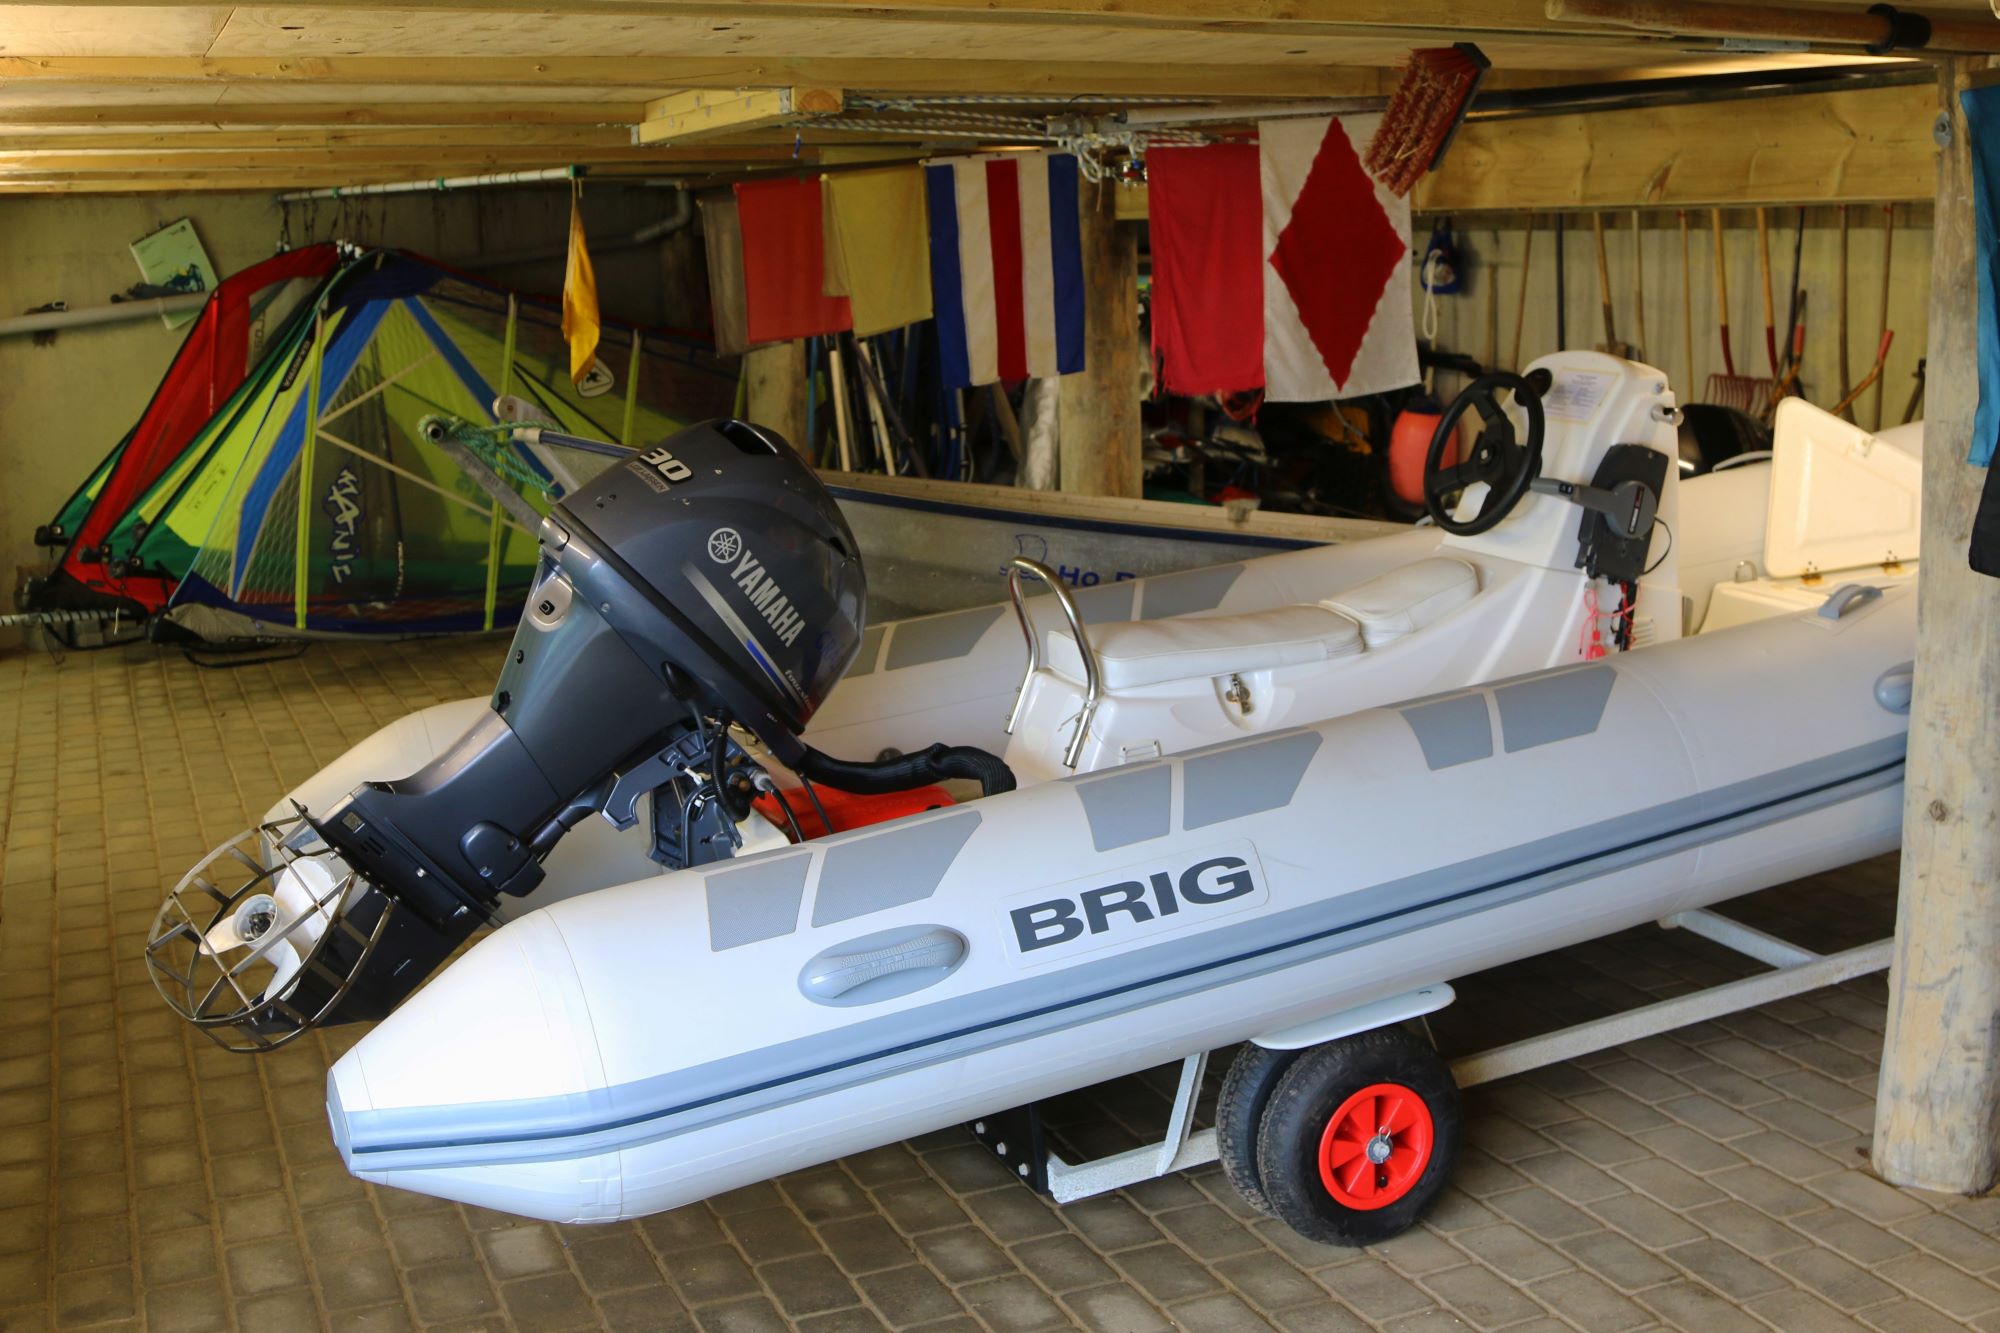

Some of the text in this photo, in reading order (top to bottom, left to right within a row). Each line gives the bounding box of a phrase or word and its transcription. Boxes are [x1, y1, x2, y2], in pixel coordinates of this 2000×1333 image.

[639, 447, 692, 481] 30
[730, 550, 806, 648] YAMAHA
[1058, 564, 1100, 587] Ho
[1009, 856, 1254, 953] BRIG
